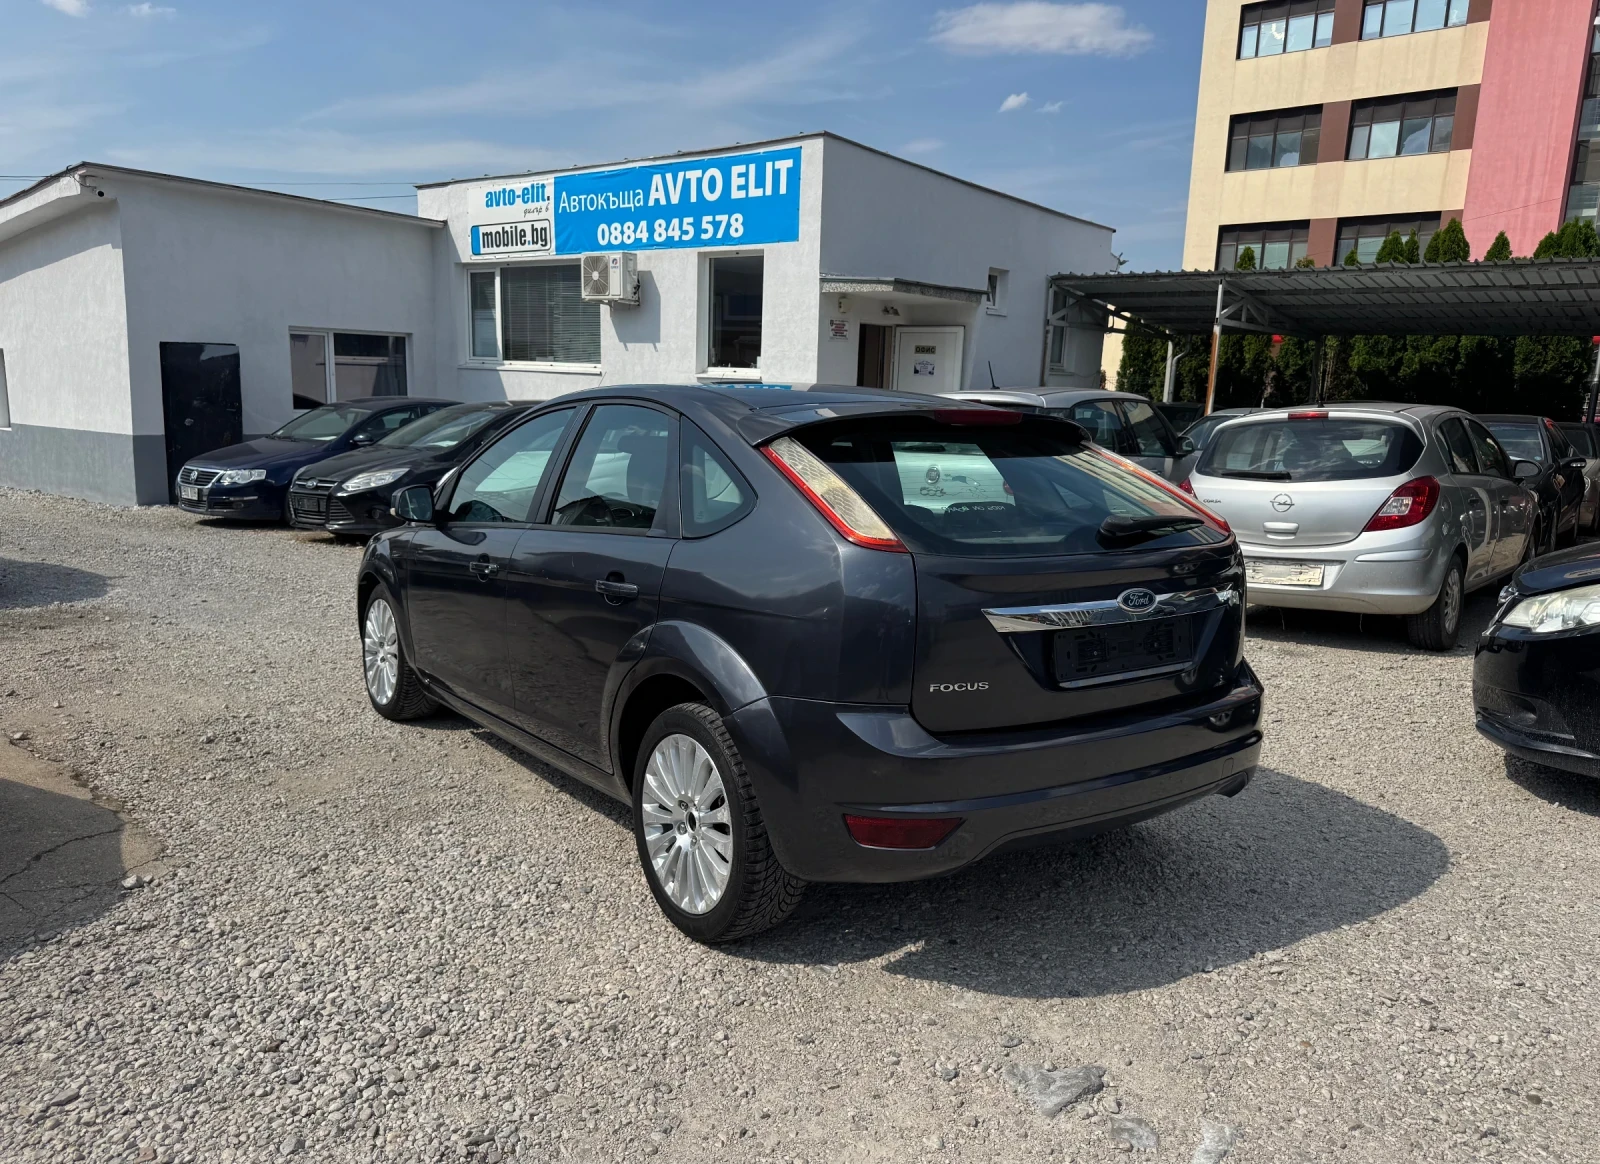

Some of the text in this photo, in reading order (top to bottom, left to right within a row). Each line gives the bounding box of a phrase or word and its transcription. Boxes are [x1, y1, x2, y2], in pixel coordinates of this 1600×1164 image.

[558, 158, 794, 214] Автокъща AVTO ELIT
[481, 223, 548, 249] mobile.bg
[597, 213, 744, 246] 0884 845 578
[1128, 592, 1150, 606] Ford
[929, 681, 989, 693] FOCUS
